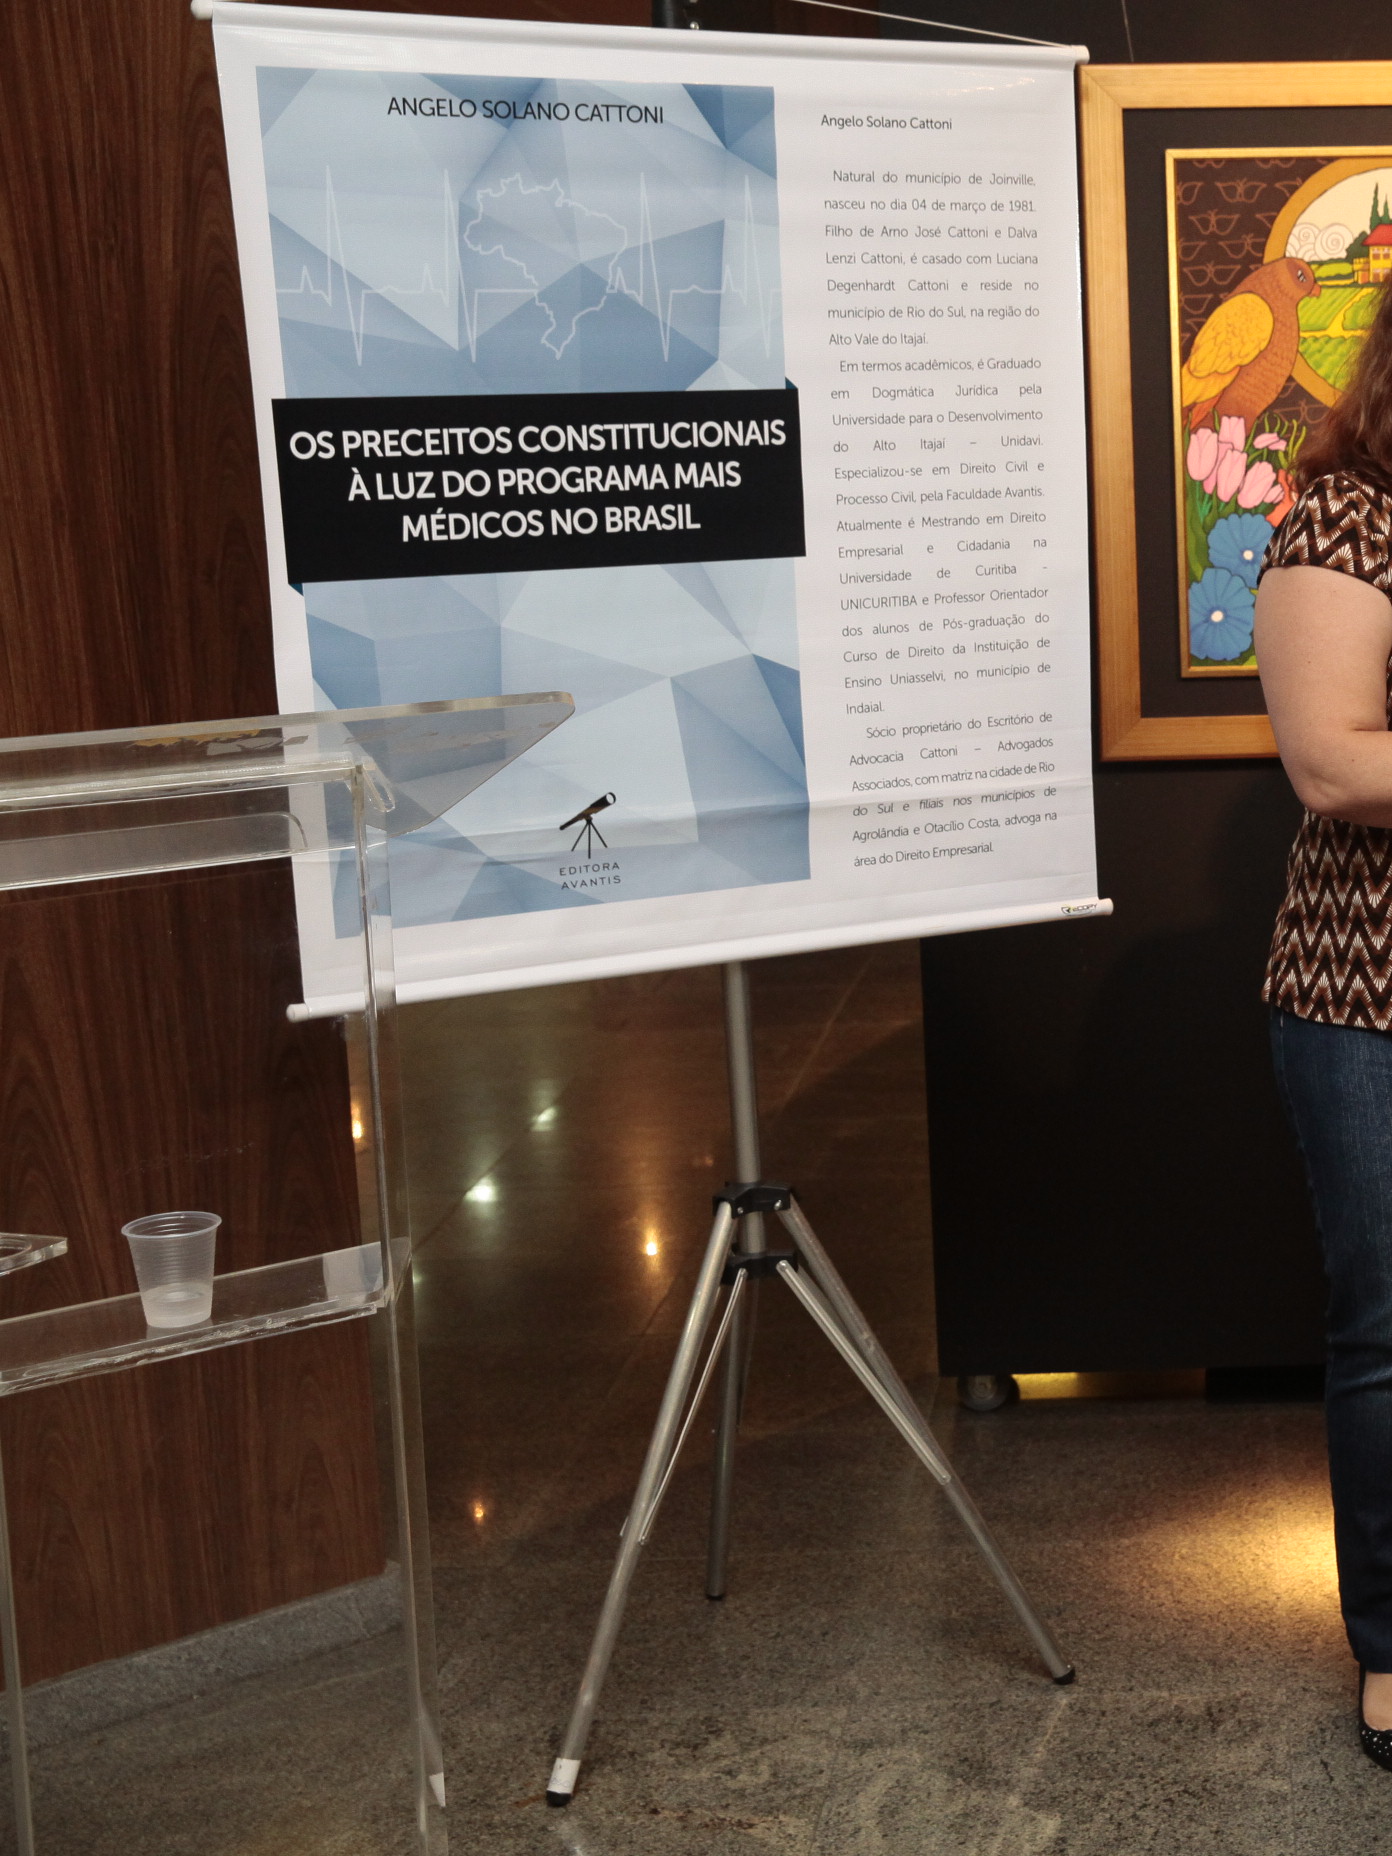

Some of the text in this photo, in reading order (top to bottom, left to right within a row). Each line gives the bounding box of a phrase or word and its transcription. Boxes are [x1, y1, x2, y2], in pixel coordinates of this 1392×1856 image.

[387, 96, 665, 124] ANGELO SOLANO CATTONI
[821, 115, 952, 129] Angelo Solano Cattoni
[834, 170, 874, 182] Natural
[883, 171, 898, 183] do
[906, 173, 961, 186] município
[969, 173, 982, 184] de
[825, 199, 1004, 213] nasceu no dia 04 de março de
[826, 225, 1037, 238] Filho de Arno José Cattoni Dalva
[826, 253, 856, 264] Lenzi
[922, 253, 962, 264] casado
[966, 256, 991, 264] com
[997, 253, 1038, 264] Luciana
[828, 280, 1039, 294] Degenhardt Cattoni reside no
[828, 306, 1039, 320] município de Rio do na região do
[829, 334, 852, 345] Alto
[855, 334, 879, 345] Vale
[882, 334, 897, 344] do
[840, 361, 858, 372] Em
[862, 362, 902, 371] termos
[987, 358, 1041, 369] Graduado
[831, 384, 1042, 400] em Dogmática Jurídica pela
[833, 410, 1043, 426] Universidade para Desenvolvimento
[289, 419, 787, 462] OS PRECEITOS CONSTITUCIONAIS
[833, 441, 848, 452] do
[873, 440, 896, 450] Alto
[921, 438, 945, 452] Itajaí
[835, 461, 1028, 481] Especializou-se em Direito Civil
[347, 461, 742, 502] À LUZ DO PROGRAMA MAIS
[837, 494, 888, 505] Processo
[921, 491, 943, 504] pela
[947, 488, 1001, 500] Faculdade
[402, 503, 701, 544] MÉDICOS NO BRASIL
[837, 512, 1046, 531] Atualmente Mestrando em Direito
[839, 539, 1047, 559] Empresarial Cidadania na
[840, 564, 1016, 584] Universidade de Curitiba
[841, 587, 1048, 610] UNICURITIBA Professor Orientador
[842, 613, 1049, 637] dos alunos de Pós-graduação do
[843, 637, 1050, 662] Curso de Direito da Instituição de
[845, 676, 882, 688] Ensino
[955, 671, 968, 679] no
[977, 664, 1030, 677] município
[1038, 663, 1050, 673] de
[867, 712, 1052, 738] Sócio proprietário do Escritório de
[850, 737, 1053, 766] Advocacia Cattoni Advogados
[914, 774, 940, 786] com
[941, 769, 973, 783] matriz
[974, 769, 988, 780] na
[989, 765, 1023, 778] cidade
[1023, 763, 1038, 775] de
[1038, 761, 1055, 774] Rio
[853, 786, 1056, 816] do Sul filiais nos municípios de
[853, 826, 909, 843] Agrolândia
[925, 821, 964, 833] Otacílio
[1005, 814, 1041, 825] advoga
[1045, 812, 1057, 820] na
[854, 850, 930, 867] área do Direito
[559, 862, 620, 876] EDITORA
[561, 875, 621, 890] AVANTIS
